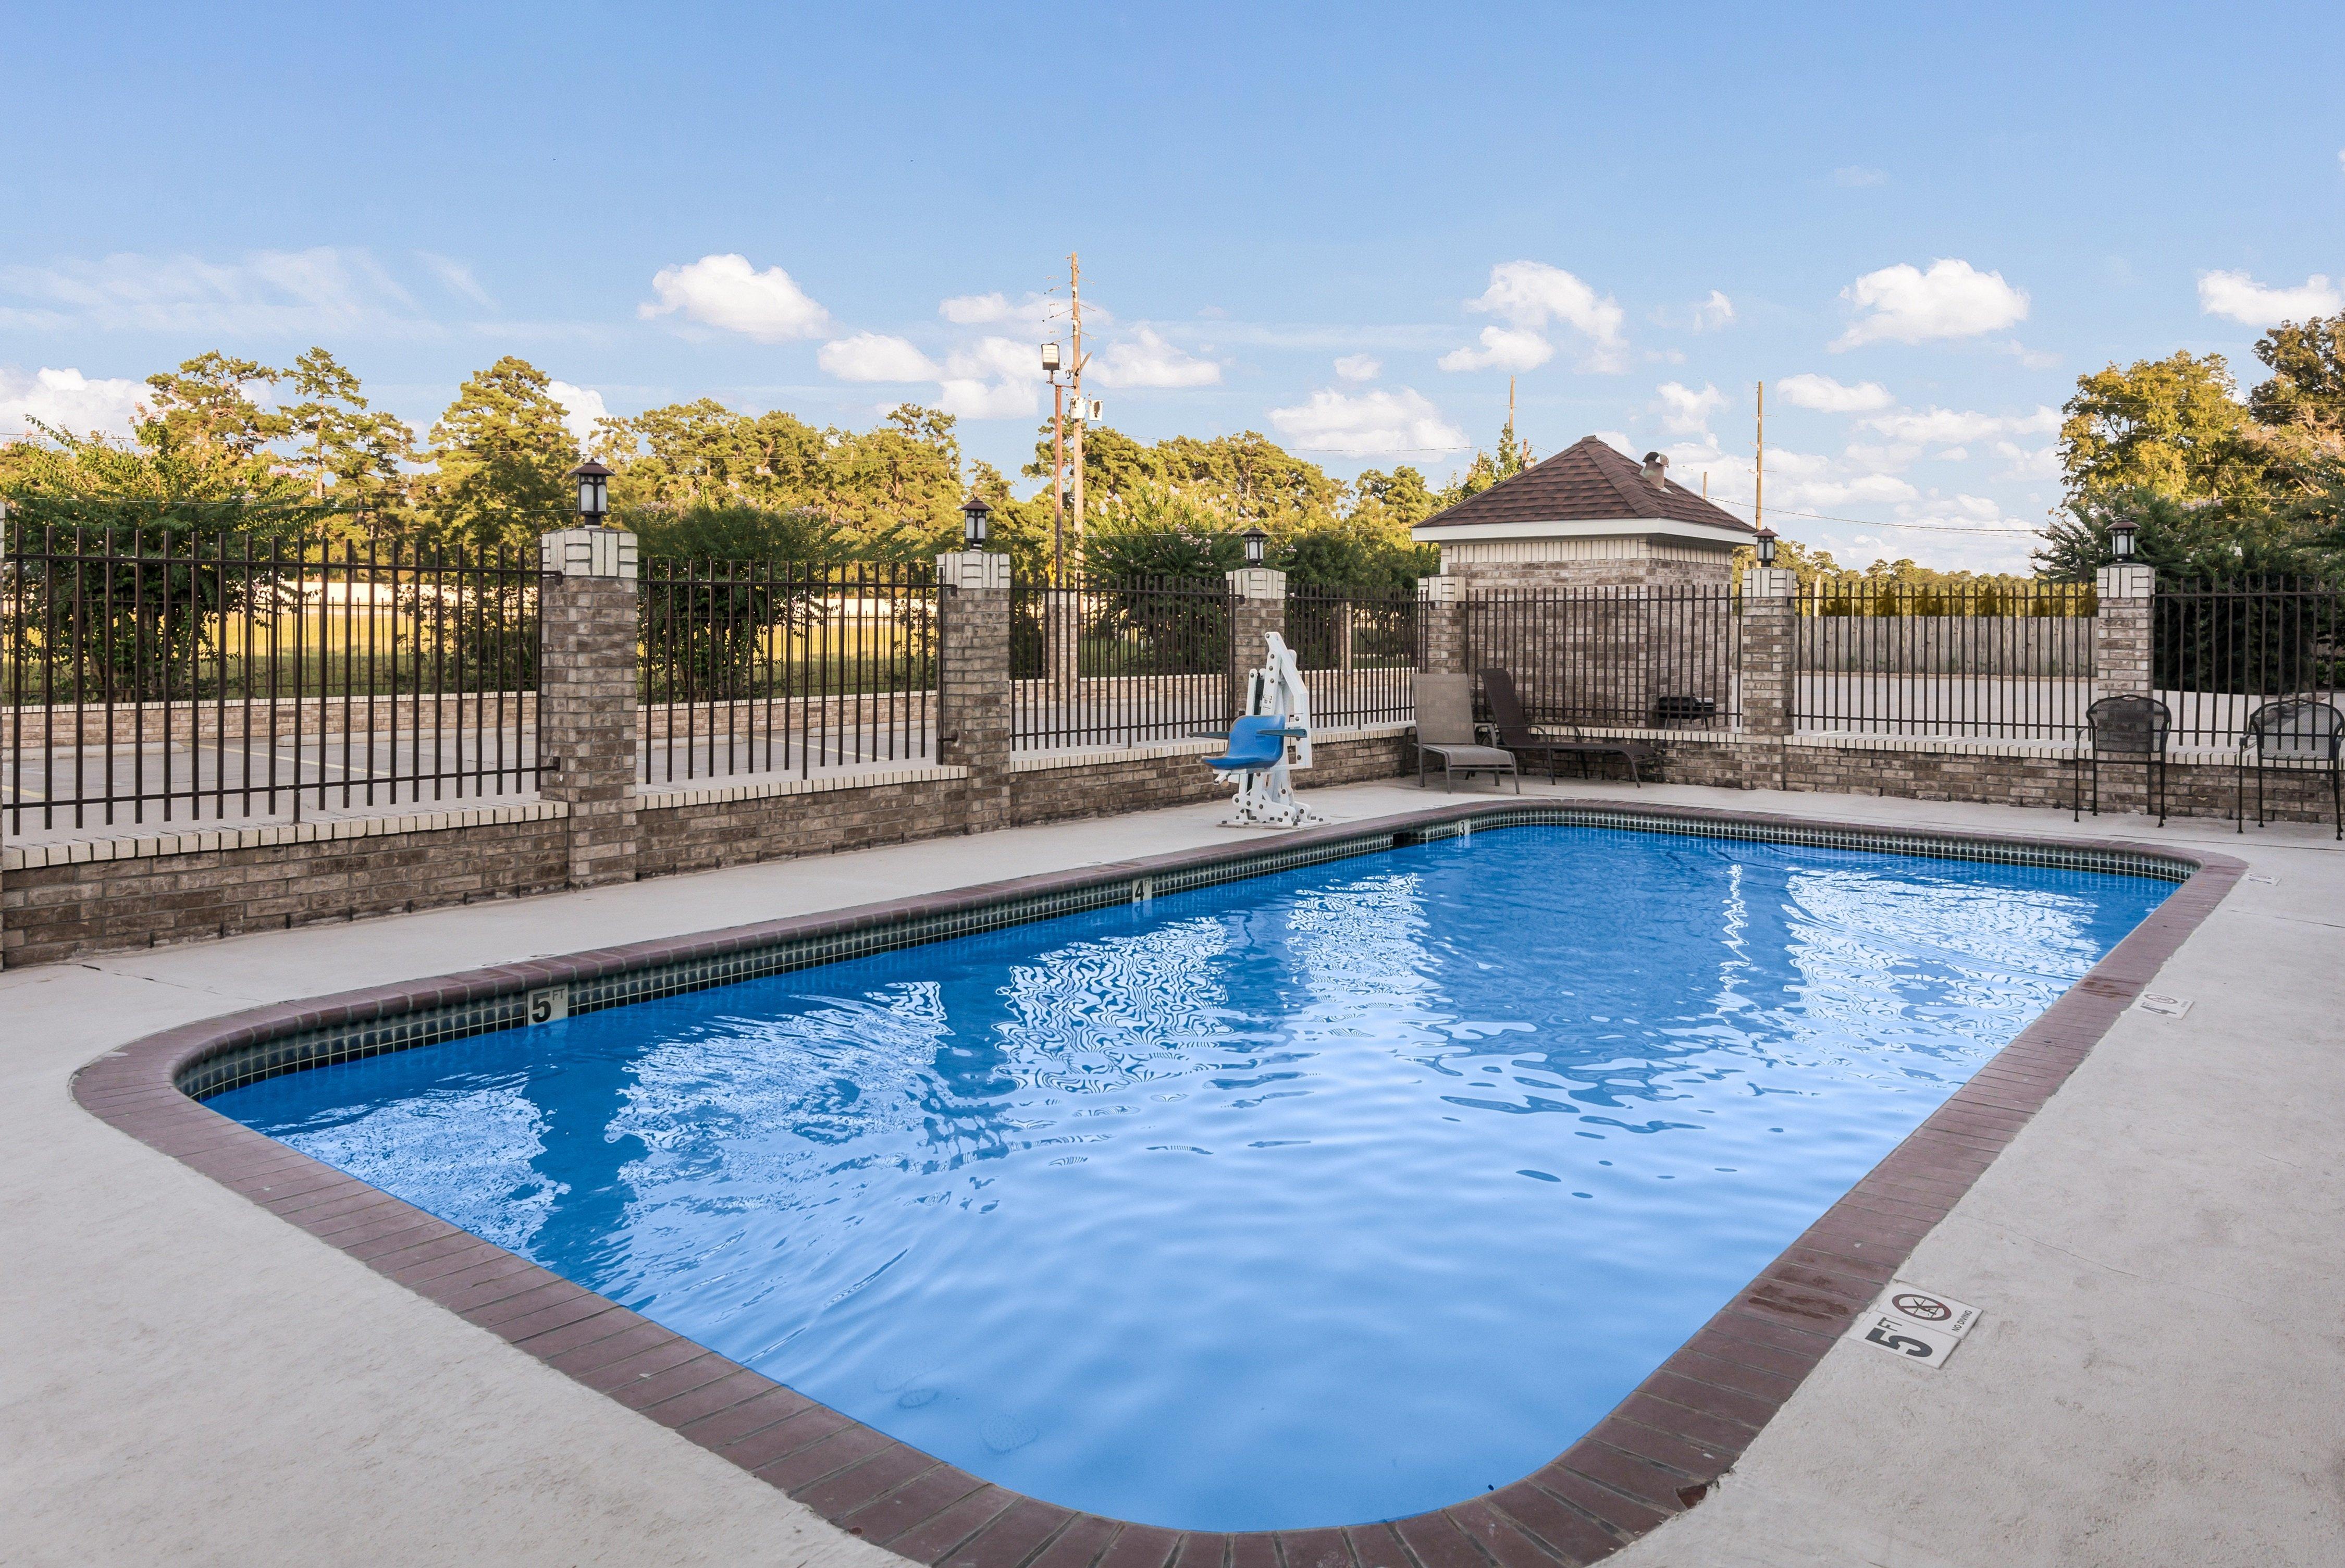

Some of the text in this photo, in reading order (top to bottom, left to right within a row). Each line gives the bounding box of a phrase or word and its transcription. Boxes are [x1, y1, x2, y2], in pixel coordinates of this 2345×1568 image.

[1460, 821, 1465, 835] 3
[1135, 879, 1151, 901] 4 FT
[532, 988, 565, 1023] 5 FT
[2140, 1005, 2177, 1015] 4
[1957, 1310, 1973, 1325] DIVING
[1865, 1317, 1933, 1357] 5 FT
